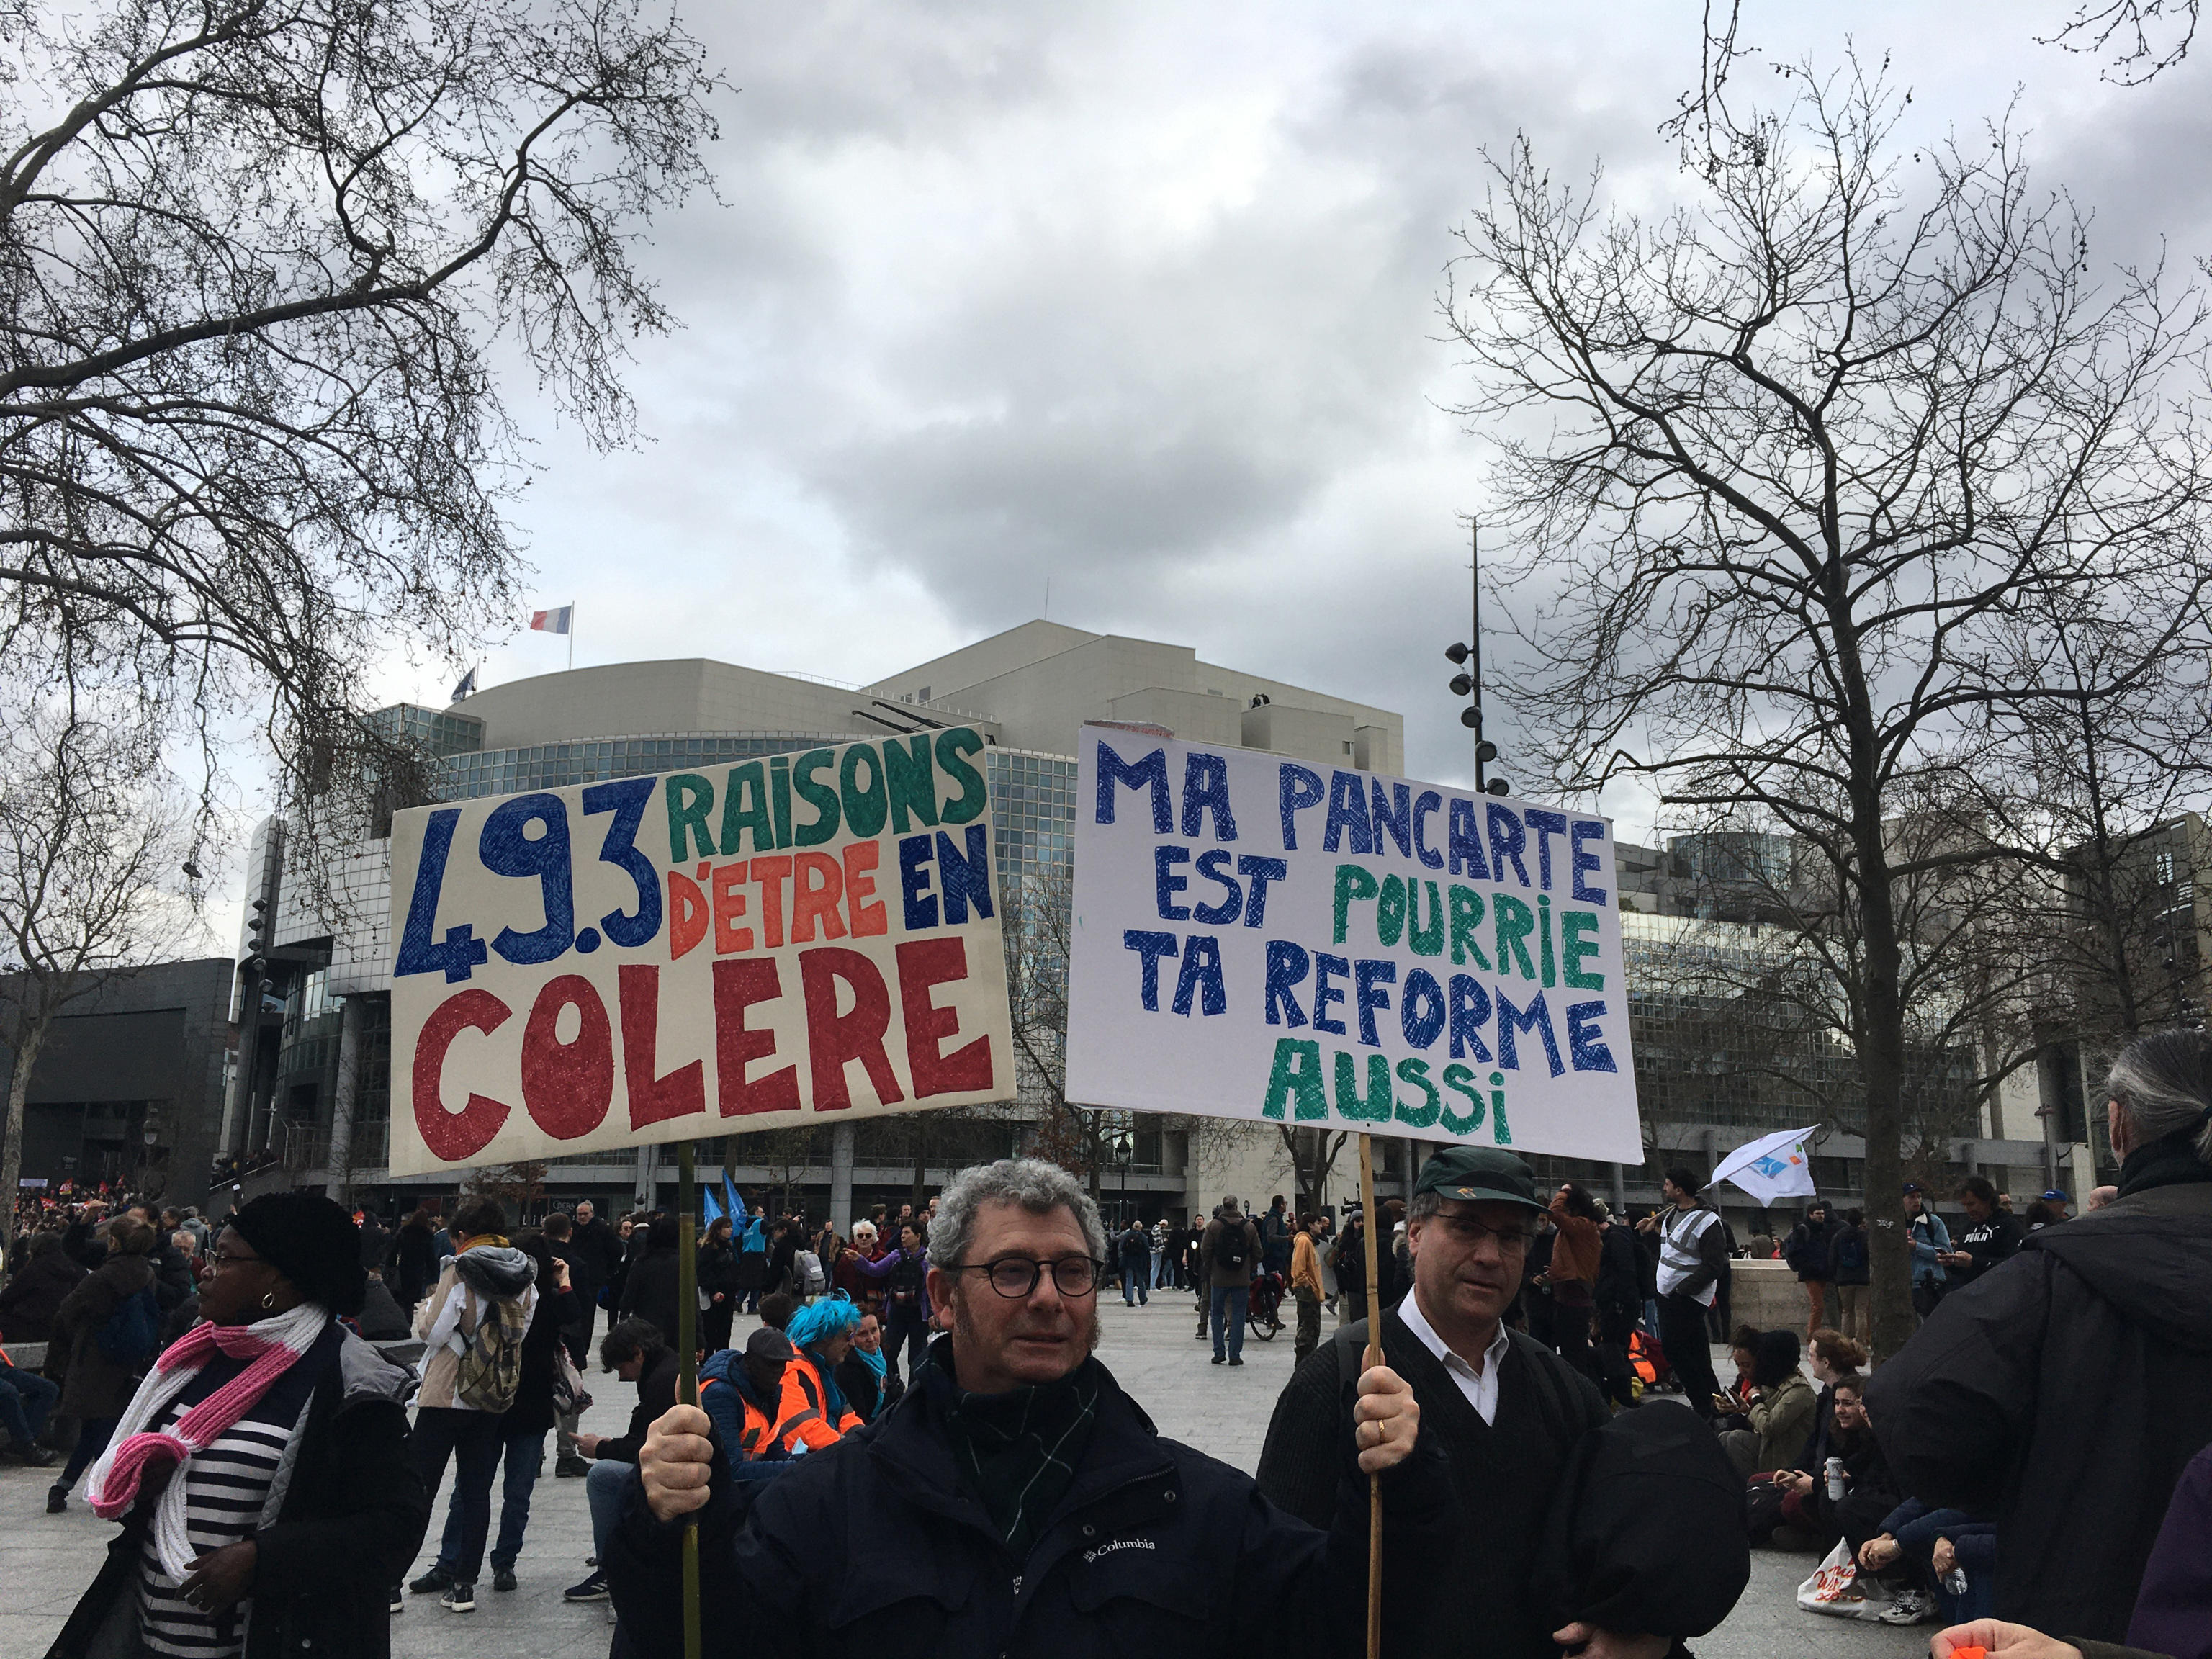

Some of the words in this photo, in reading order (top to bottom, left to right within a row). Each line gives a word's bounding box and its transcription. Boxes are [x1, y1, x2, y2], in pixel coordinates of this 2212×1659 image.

[394, 777, 662, 984] 49.3
[668, 840, 887, 961] D'ETRE
[899, 824, 994, 930] EN
[1096, 740, 1237, 841] MA
[1280, 764, 1606, 906] PANCARTE
[1155, 845, 1287, 928] EST
[413, 937, 993, 1161] COLERE
[1123, 930, 1226, 1017] TA
[1265, 940, 1617, 1077] REFORME
[1097, 1538, 1156, 1556] Columbia
